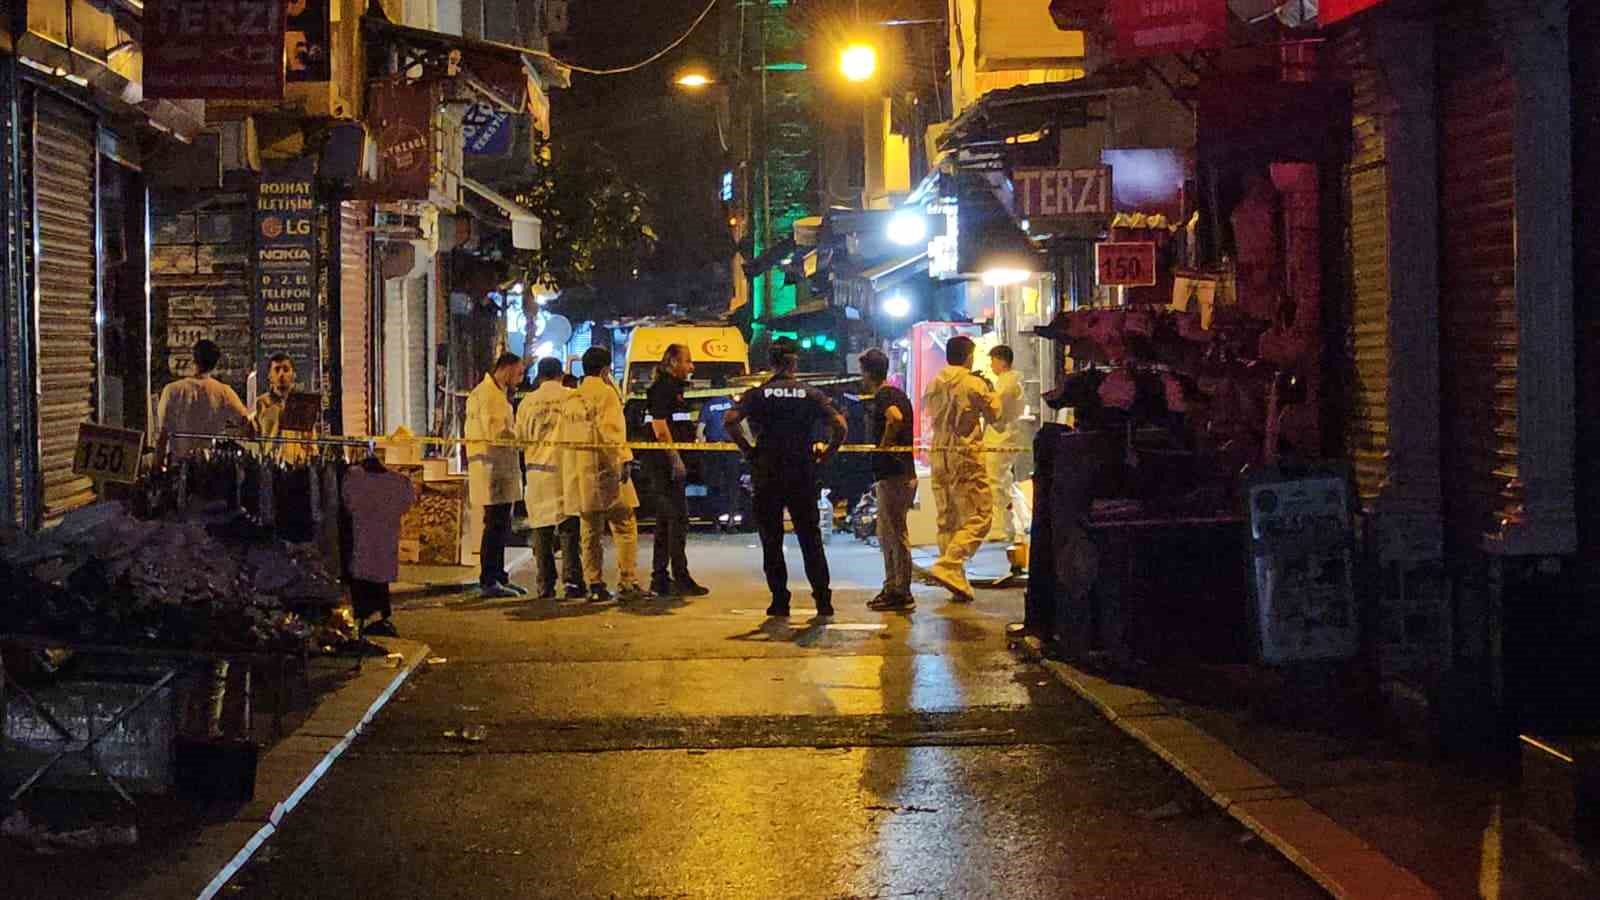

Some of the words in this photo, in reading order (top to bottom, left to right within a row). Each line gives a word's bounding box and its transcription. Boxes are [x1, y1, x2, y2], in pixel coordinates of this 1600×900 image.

[286, 220, 310, 235] LG
[259, 248, 311, 260] NOKIA
[1103, 256, 1141, 279] 150
[261, 289, 311, 299] TELEFON
[82, 441, 124, 473] 150
